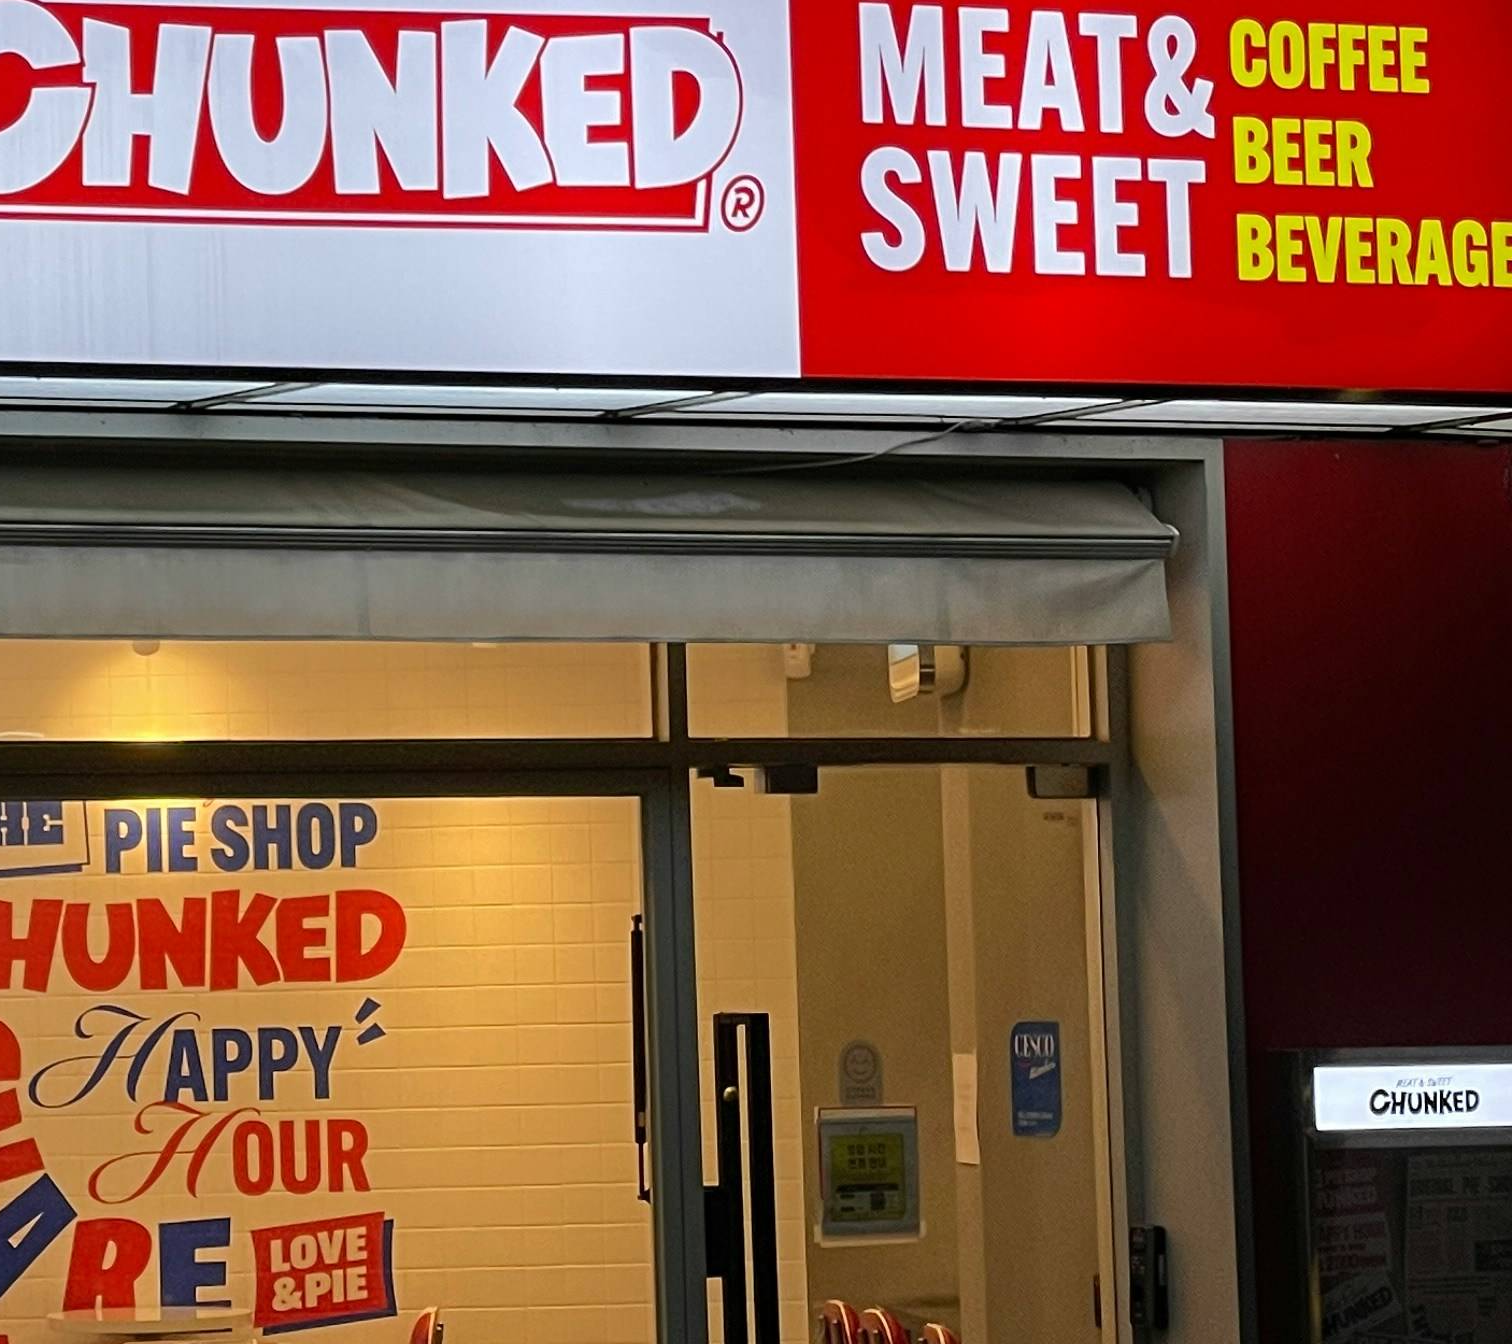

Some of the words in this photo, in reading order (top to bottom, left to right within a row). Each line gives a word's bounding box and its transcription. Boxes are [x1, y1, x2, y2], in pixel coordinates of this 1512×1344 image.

[859, 1, 1215, 139] MEAT&
[1229, 18, 1430, 93] COFFEE
[1232, 117, 1374, 187] BEER
[860, 146, 1206, 278] SWEET
[104, 806, 198, 873] PIE
[210, 803, 378, 872] SHOP
[28, 1004, 342, 1108] HAPPY
[1370, 1089, 1480, 1116] CHUNKED
[88, 1102, 370, 1204] HOUR
[269, 1226, 368, 1273] LOVE
